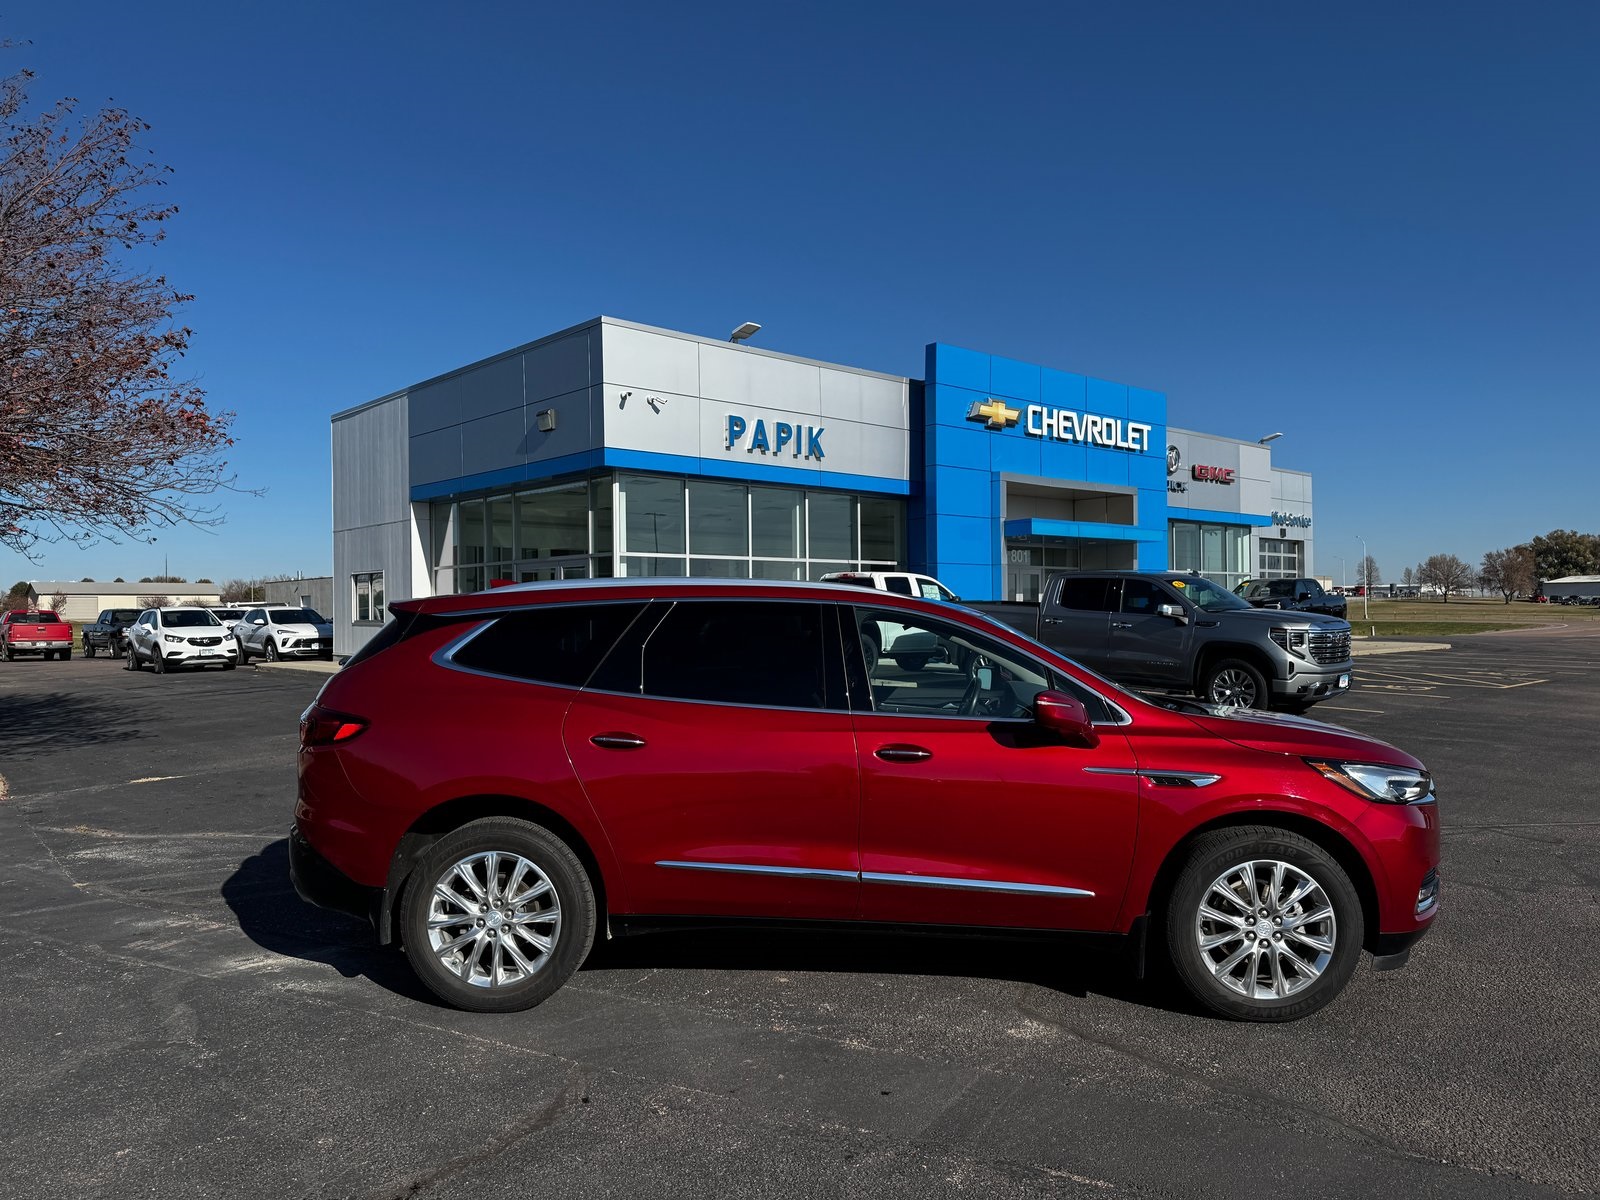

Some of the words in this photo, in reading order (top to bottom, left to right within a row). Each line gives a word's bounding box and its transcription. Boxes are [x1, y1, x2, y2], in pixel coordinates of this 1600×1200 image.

[726, 414, 826, 460] PAPIK
[1027, 404, 1151, 451] CHEVROLET
[1193, 464, 1235, 483] GMC
[1010, 549, 1028, 563] 801
[1258, 843, 1297, 858] YEAR
